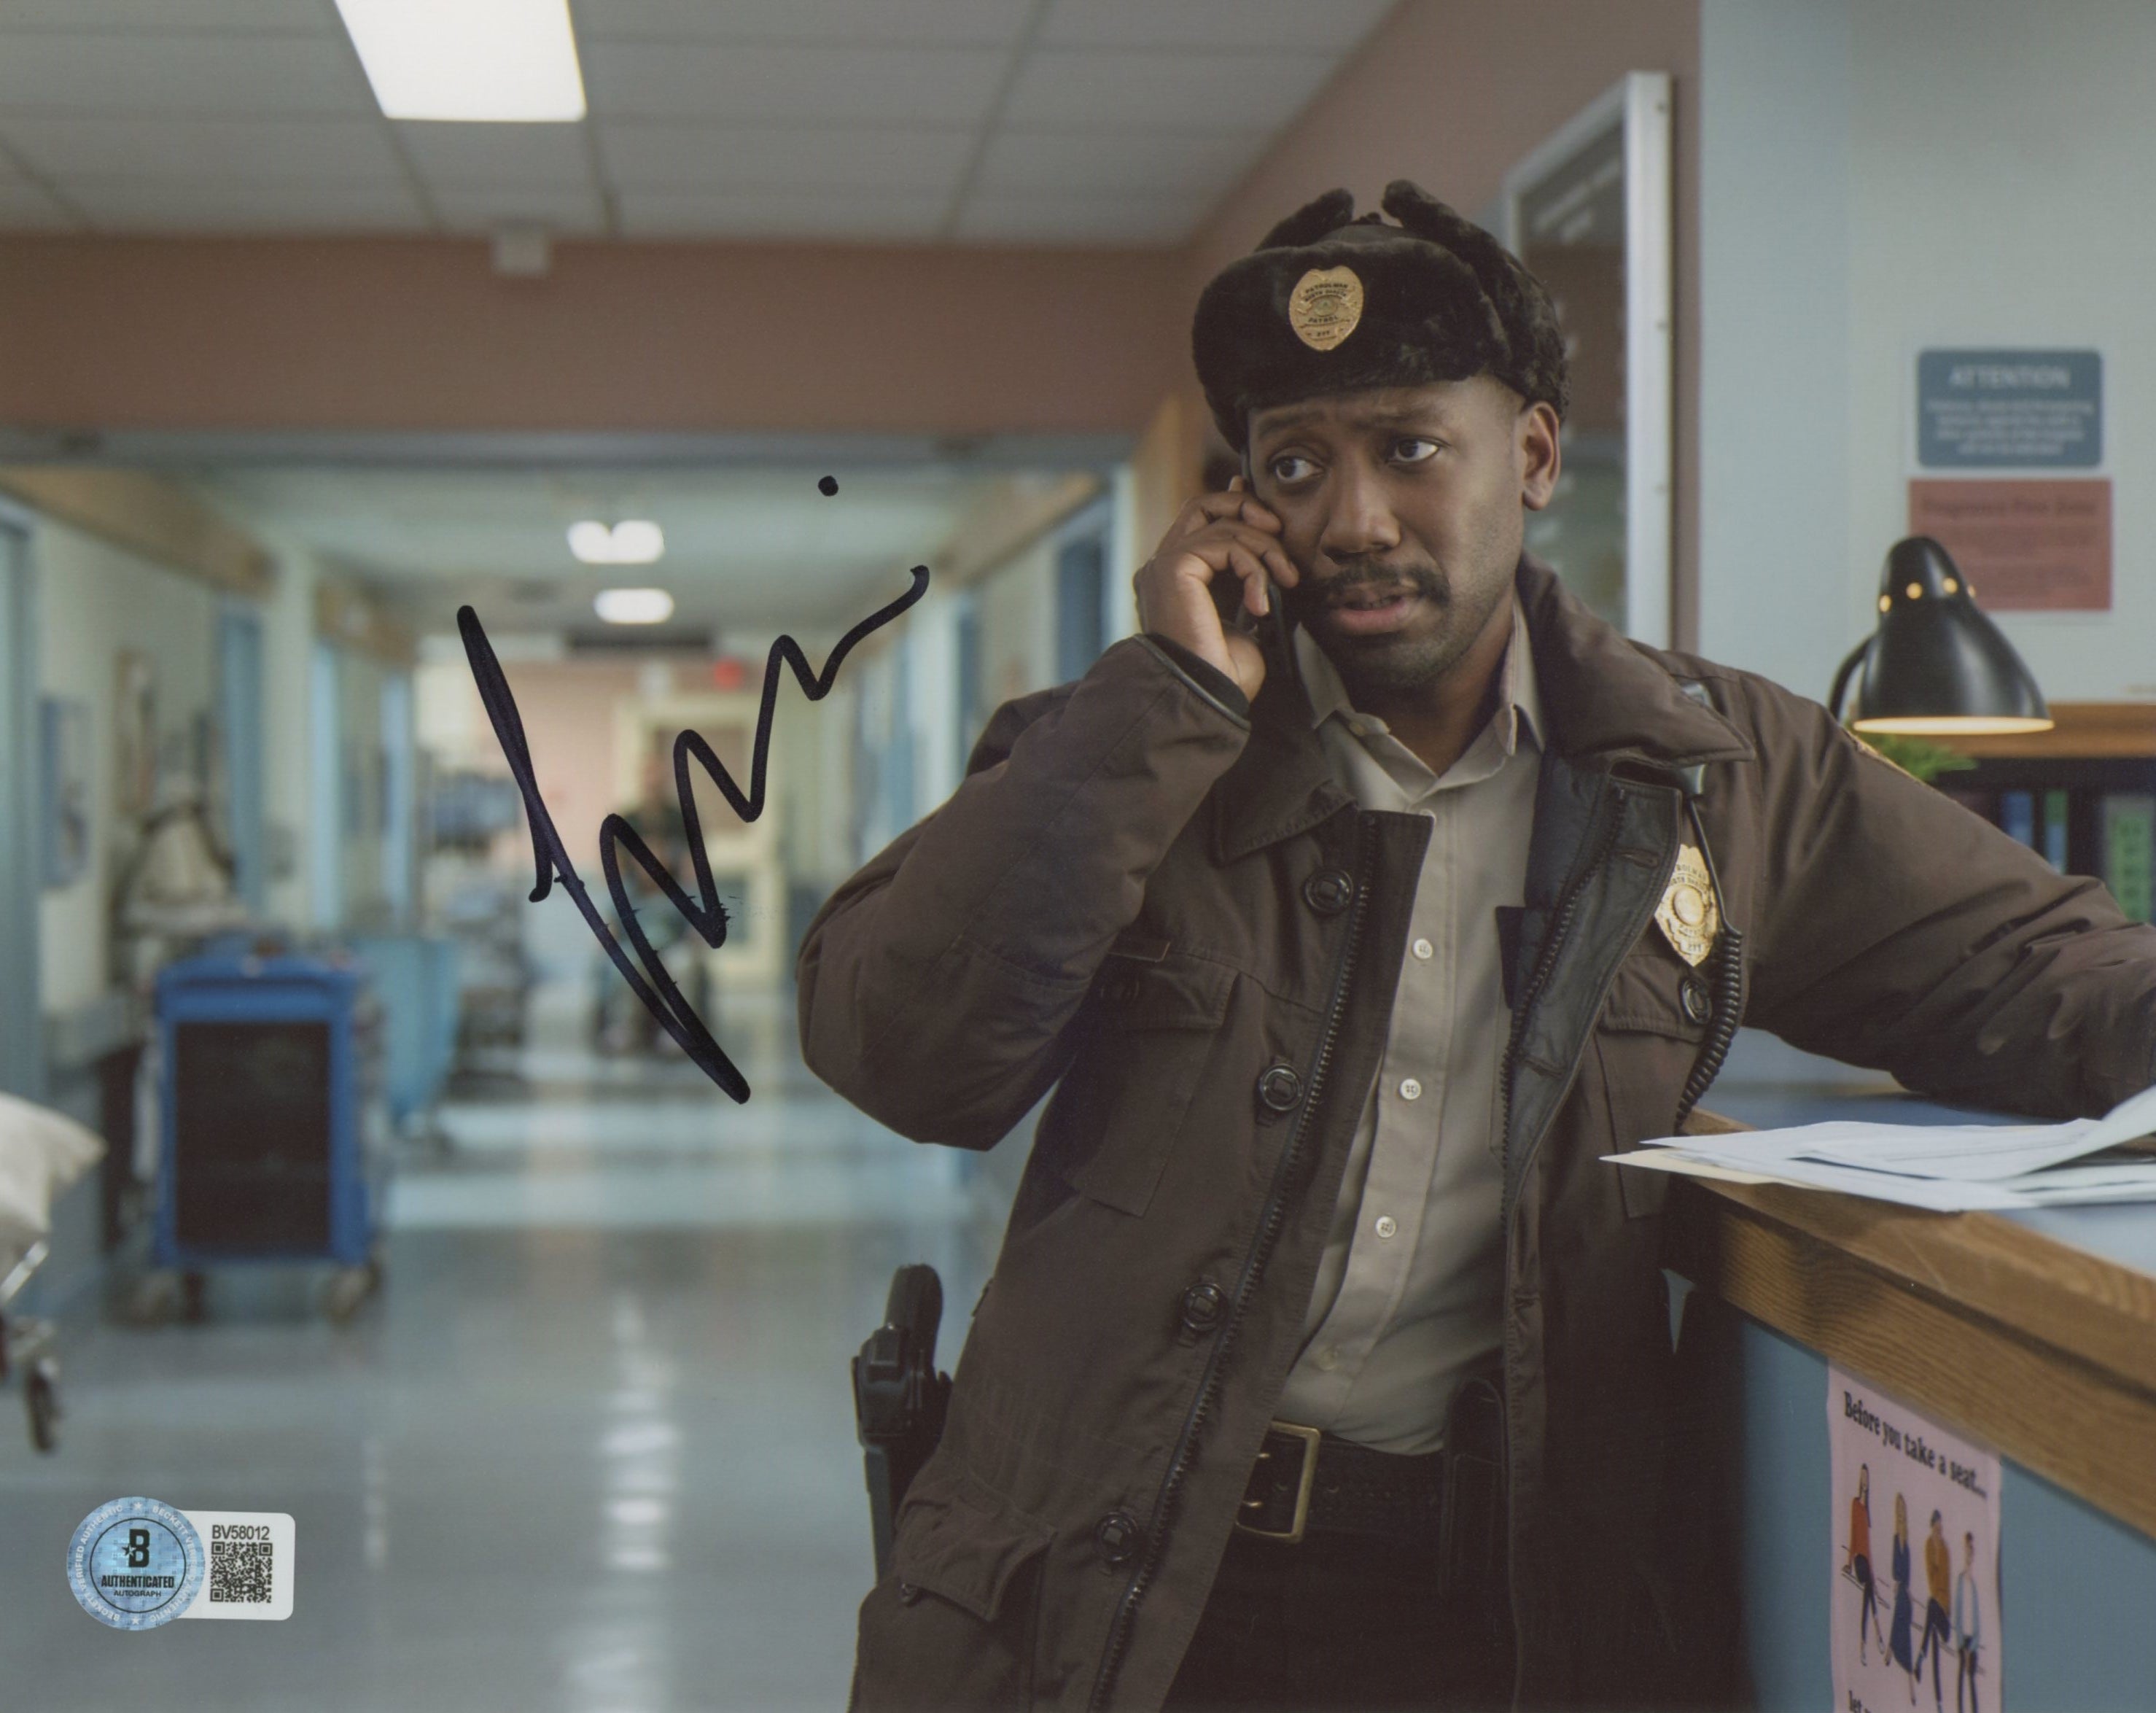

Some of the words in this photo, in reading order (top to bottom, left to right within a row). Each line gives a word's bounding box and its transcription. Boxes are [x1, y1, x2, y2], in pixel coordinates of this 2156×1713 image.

[1307, 315, 1338, 323] PATROL
[1949, 366, 2070, 388] ATTENTION
[1845, 1391, 1880, 1435] Before
[1883, 1421, 1901, 1450] you
[1904, 1434, 1934, 1469] take
[1939, 1455, 1946, 1475] a
